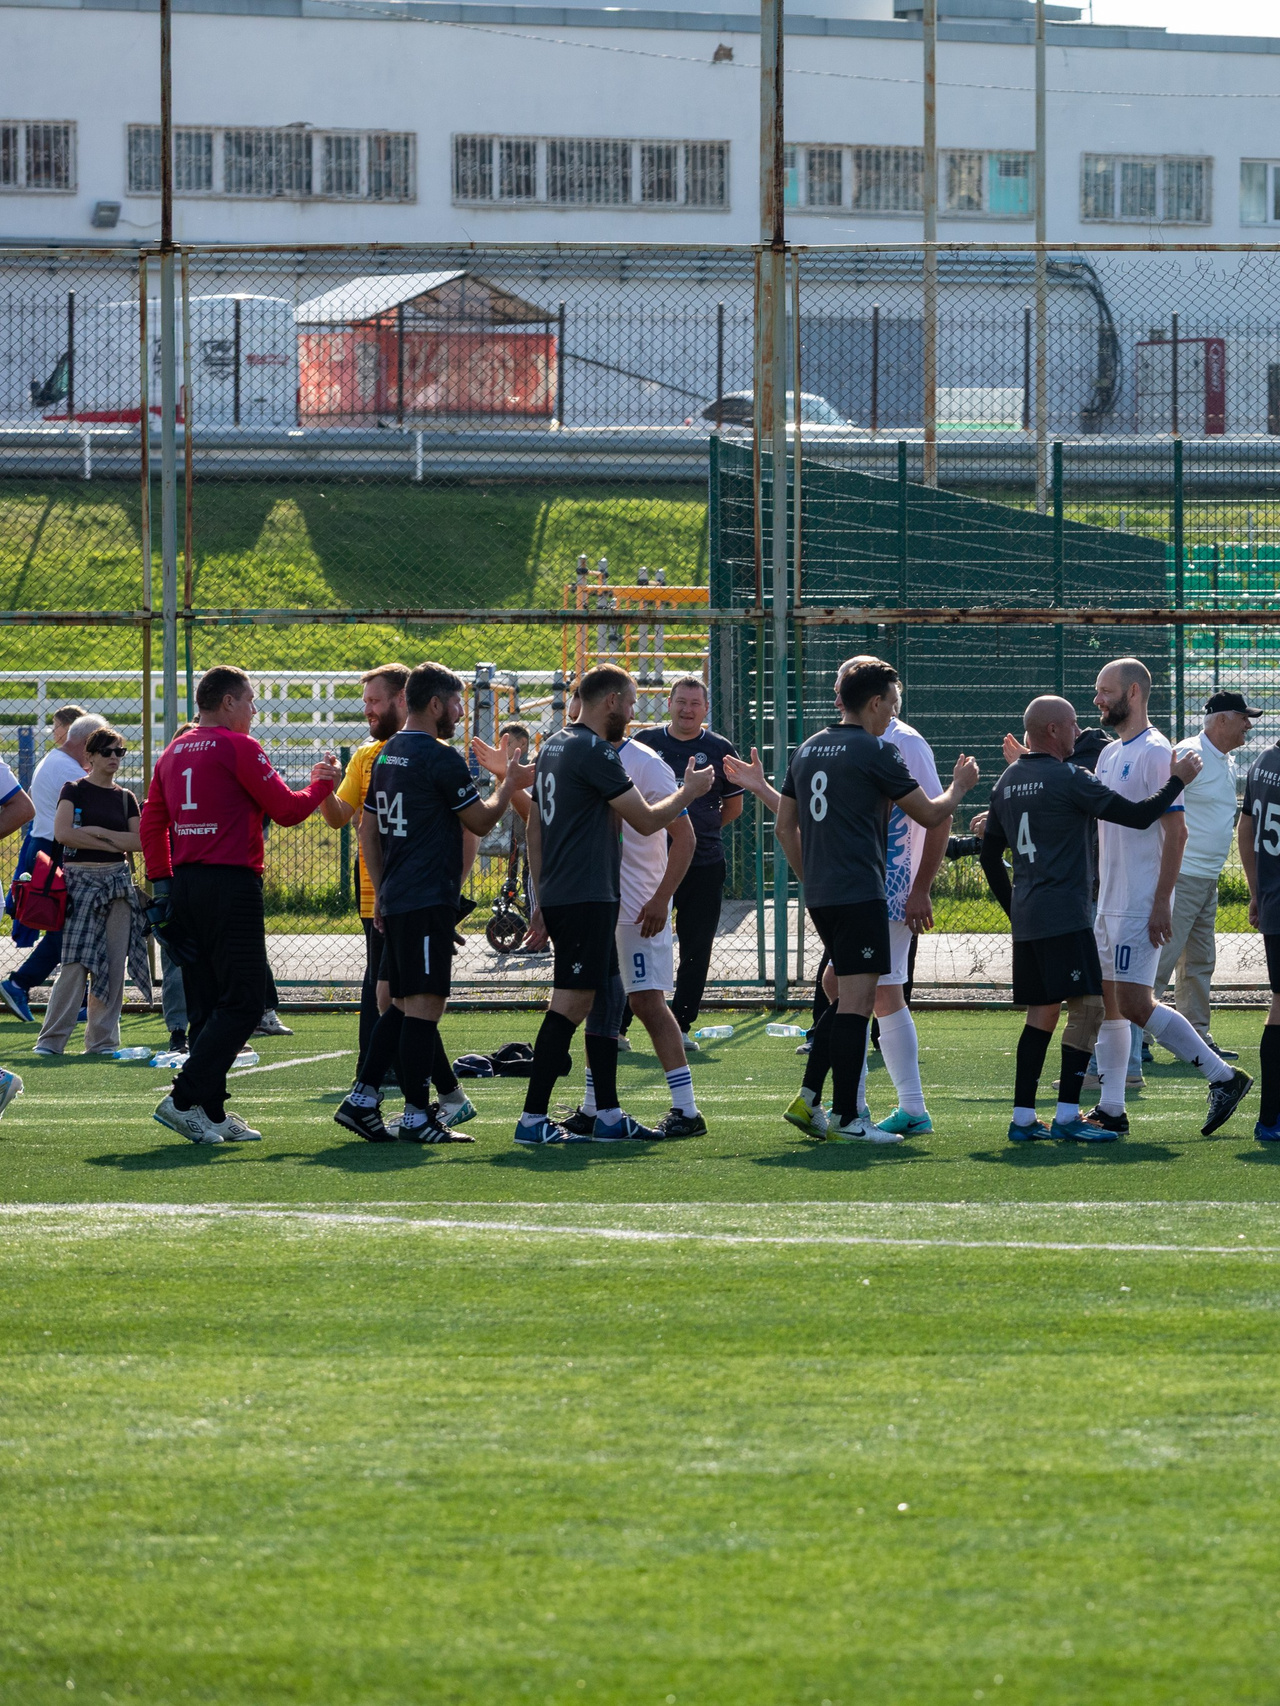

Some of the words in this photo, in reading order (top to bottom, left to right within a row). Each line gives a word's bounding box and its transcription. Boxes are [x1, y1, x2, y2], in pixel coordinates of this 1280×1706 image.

[811, 744, 847, 753] РИМЕРА
[181, 767, 198, 811] 1
[536, 771, 556, 826] 13
[809, 770, 828, 822] 8
[1011, 781, 1044, 793] РИМЕРА
[178, 827, 219, 836] TATNEFT
[1016, 811, 1037, 864] 4
[632, 952, 646, 979] 9
[1114, 944, 1132, 971] 10
